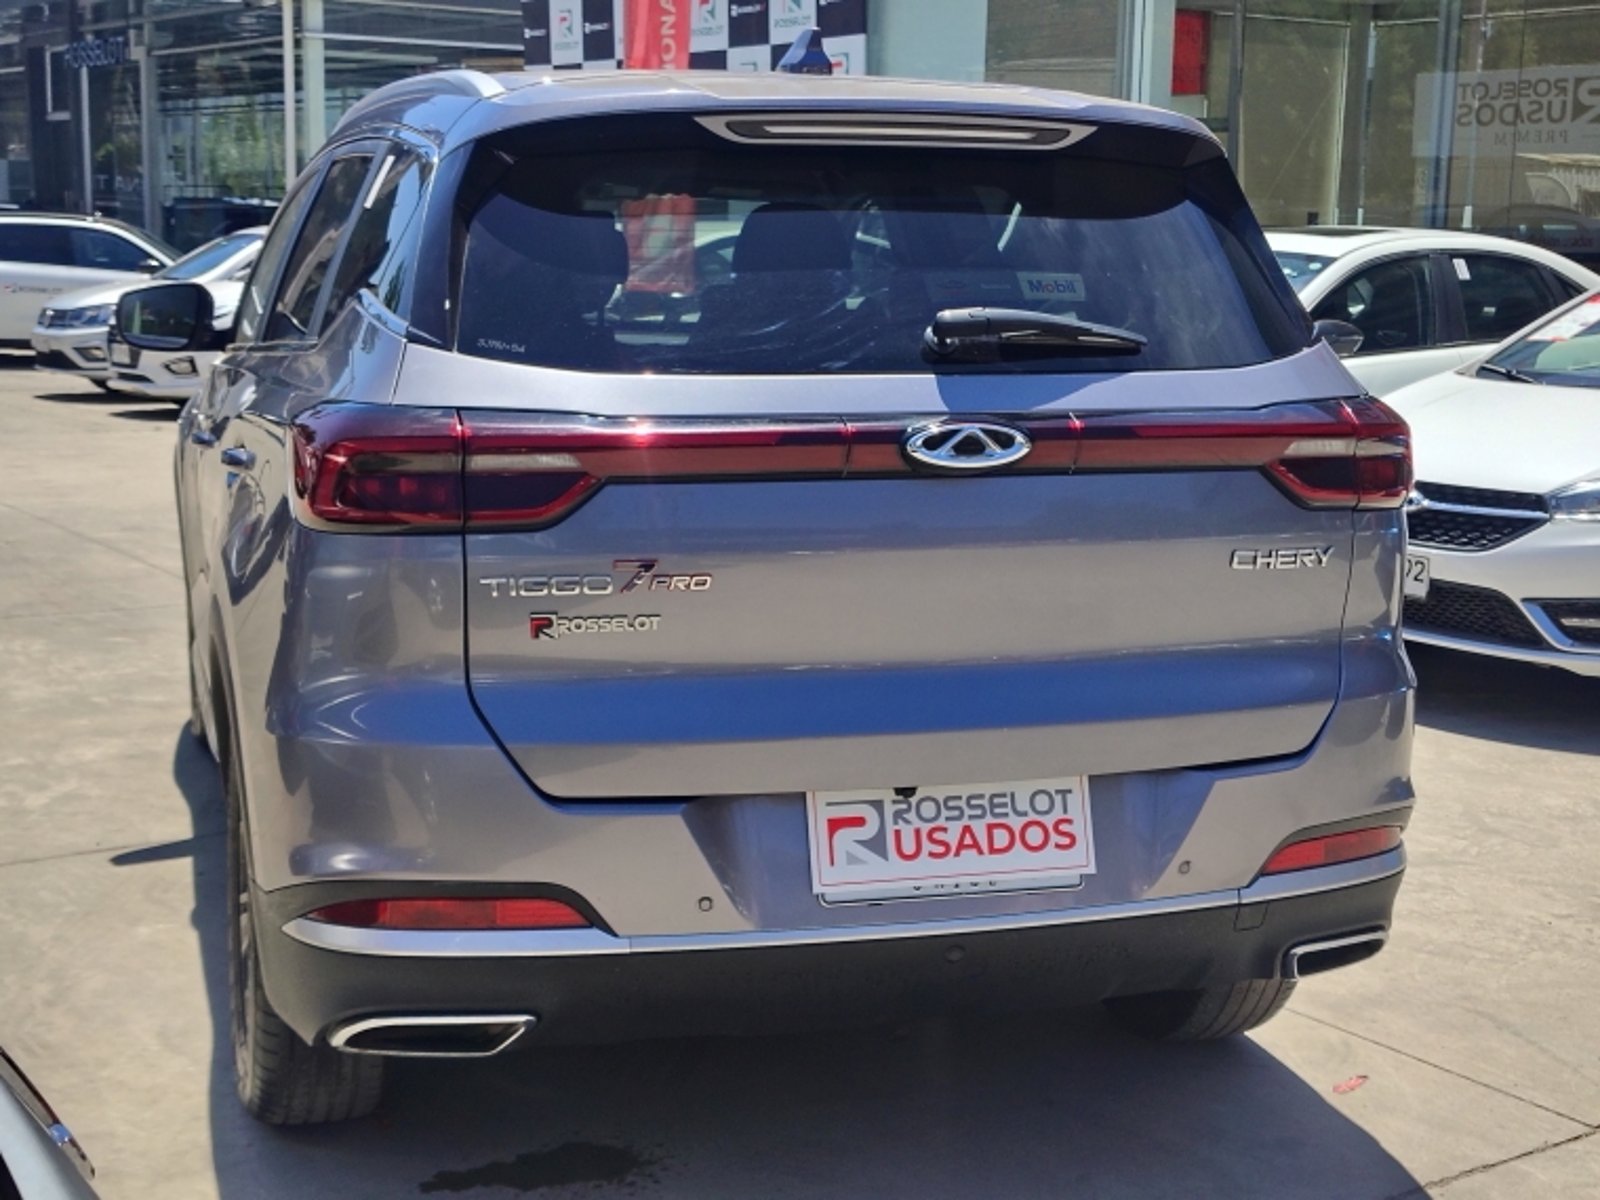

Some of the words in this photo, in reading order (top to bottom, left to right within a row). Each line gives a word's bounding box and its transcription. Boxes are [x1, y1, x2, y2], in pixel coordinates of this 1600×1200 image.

[1027, 279, 1077, 293] Mobil
[1229, 544, 1335, 570] CHERY
[479, 575, 613, 597] TIGGO
[612, 558, 658, 594] 7
[651, 574, 713, 592] PRO
[556, 614, 662, 635] ROSSELOT
[891, 788, 1073, 825] ROSSELOT
[893, 818, 1077, 862] USADOS
